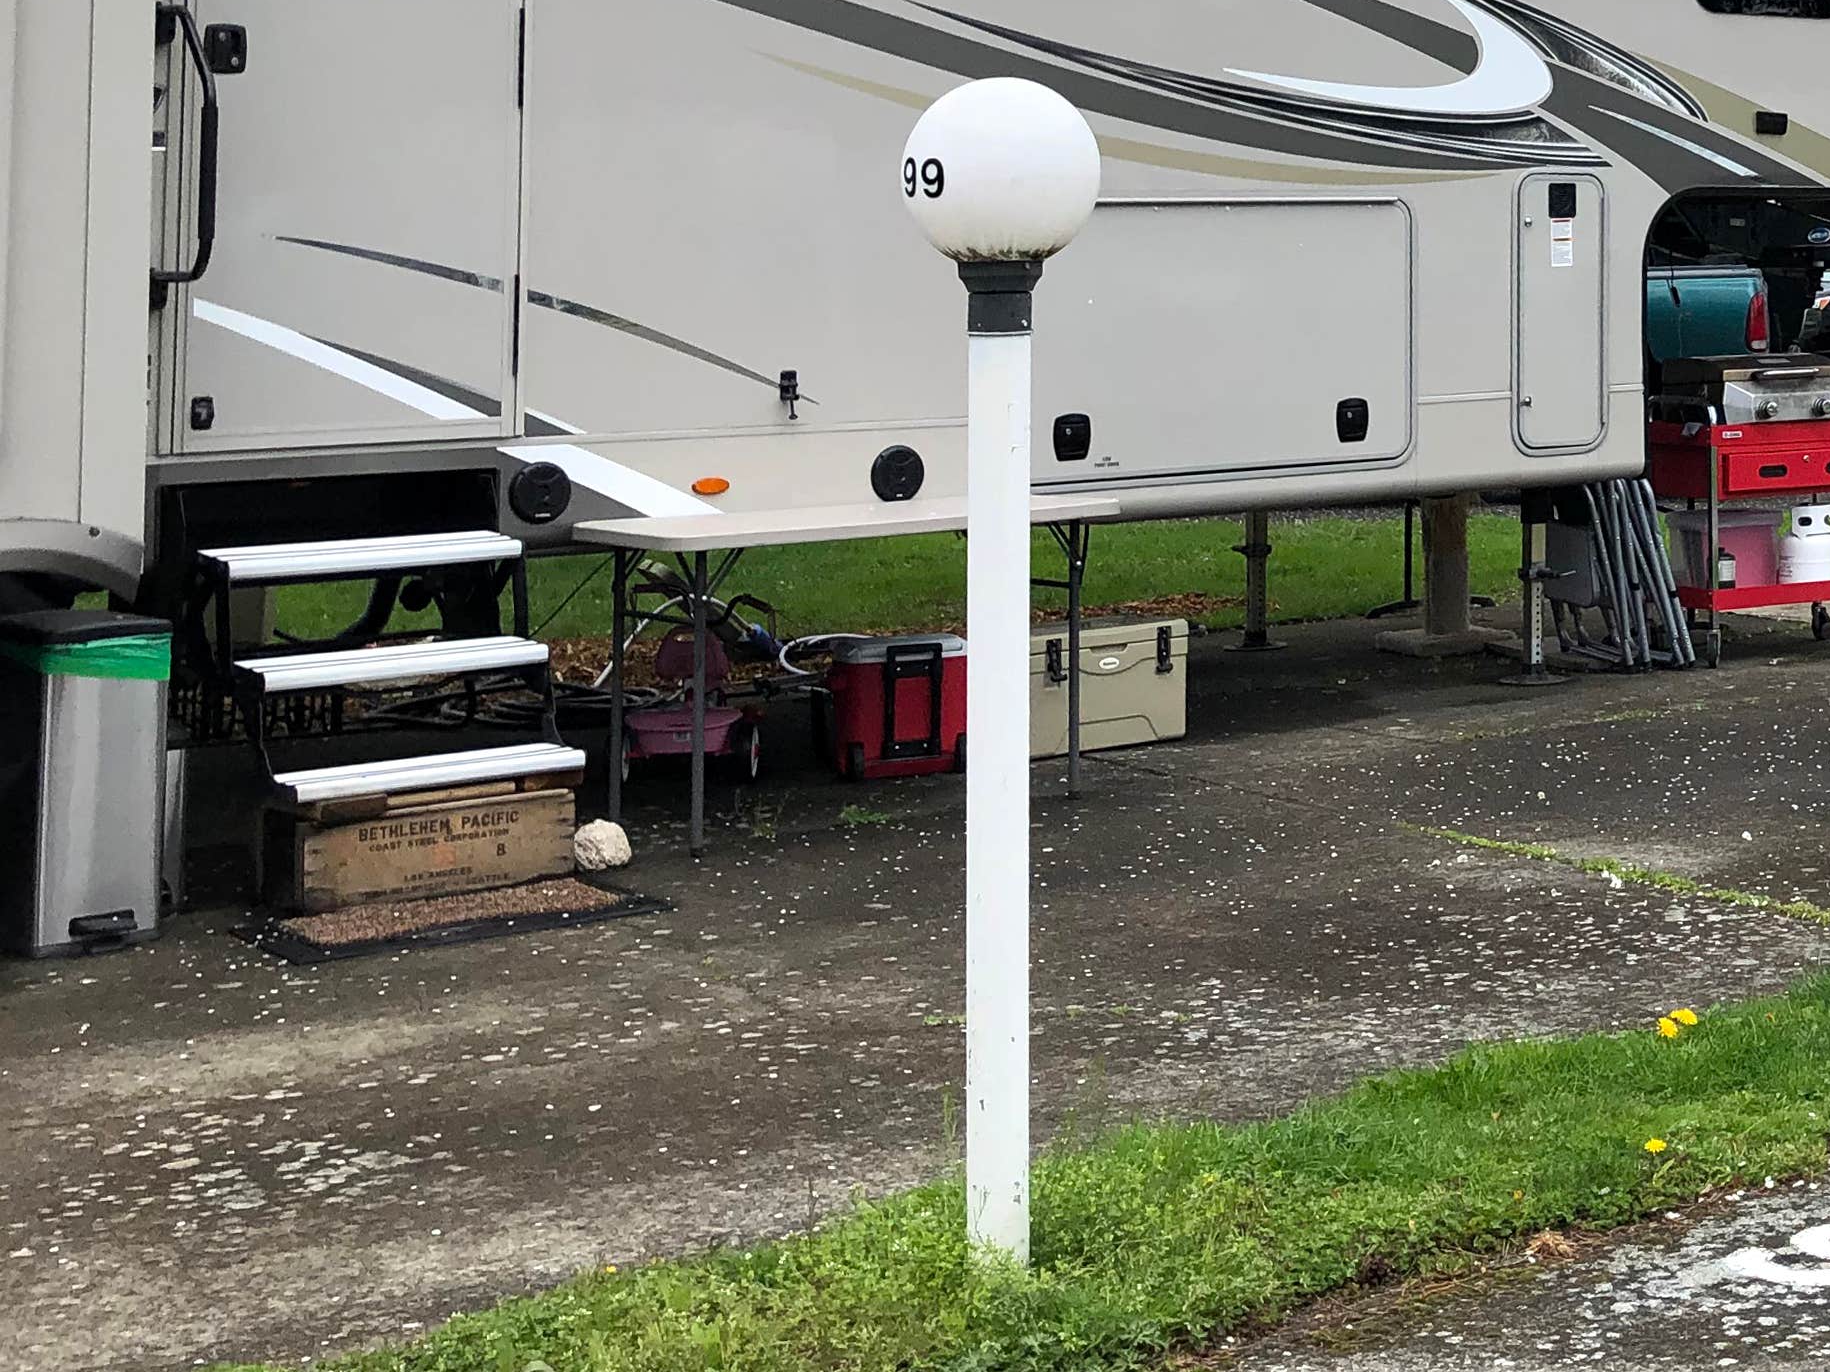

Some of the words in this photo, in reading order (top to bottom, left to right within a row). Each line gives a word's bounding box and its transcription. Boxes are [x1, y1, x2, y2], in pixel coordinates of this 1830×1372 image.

[904, 157, 945, 199] 99
[358, 819, 450, 841] BETHLEHEM
[461, 810, 519, 828] PACIFIC
[369, 841, 400, 853] COAST
[408, 837, 438, 847] STEEL
[444, 828, 509, 842] CORPORATION
